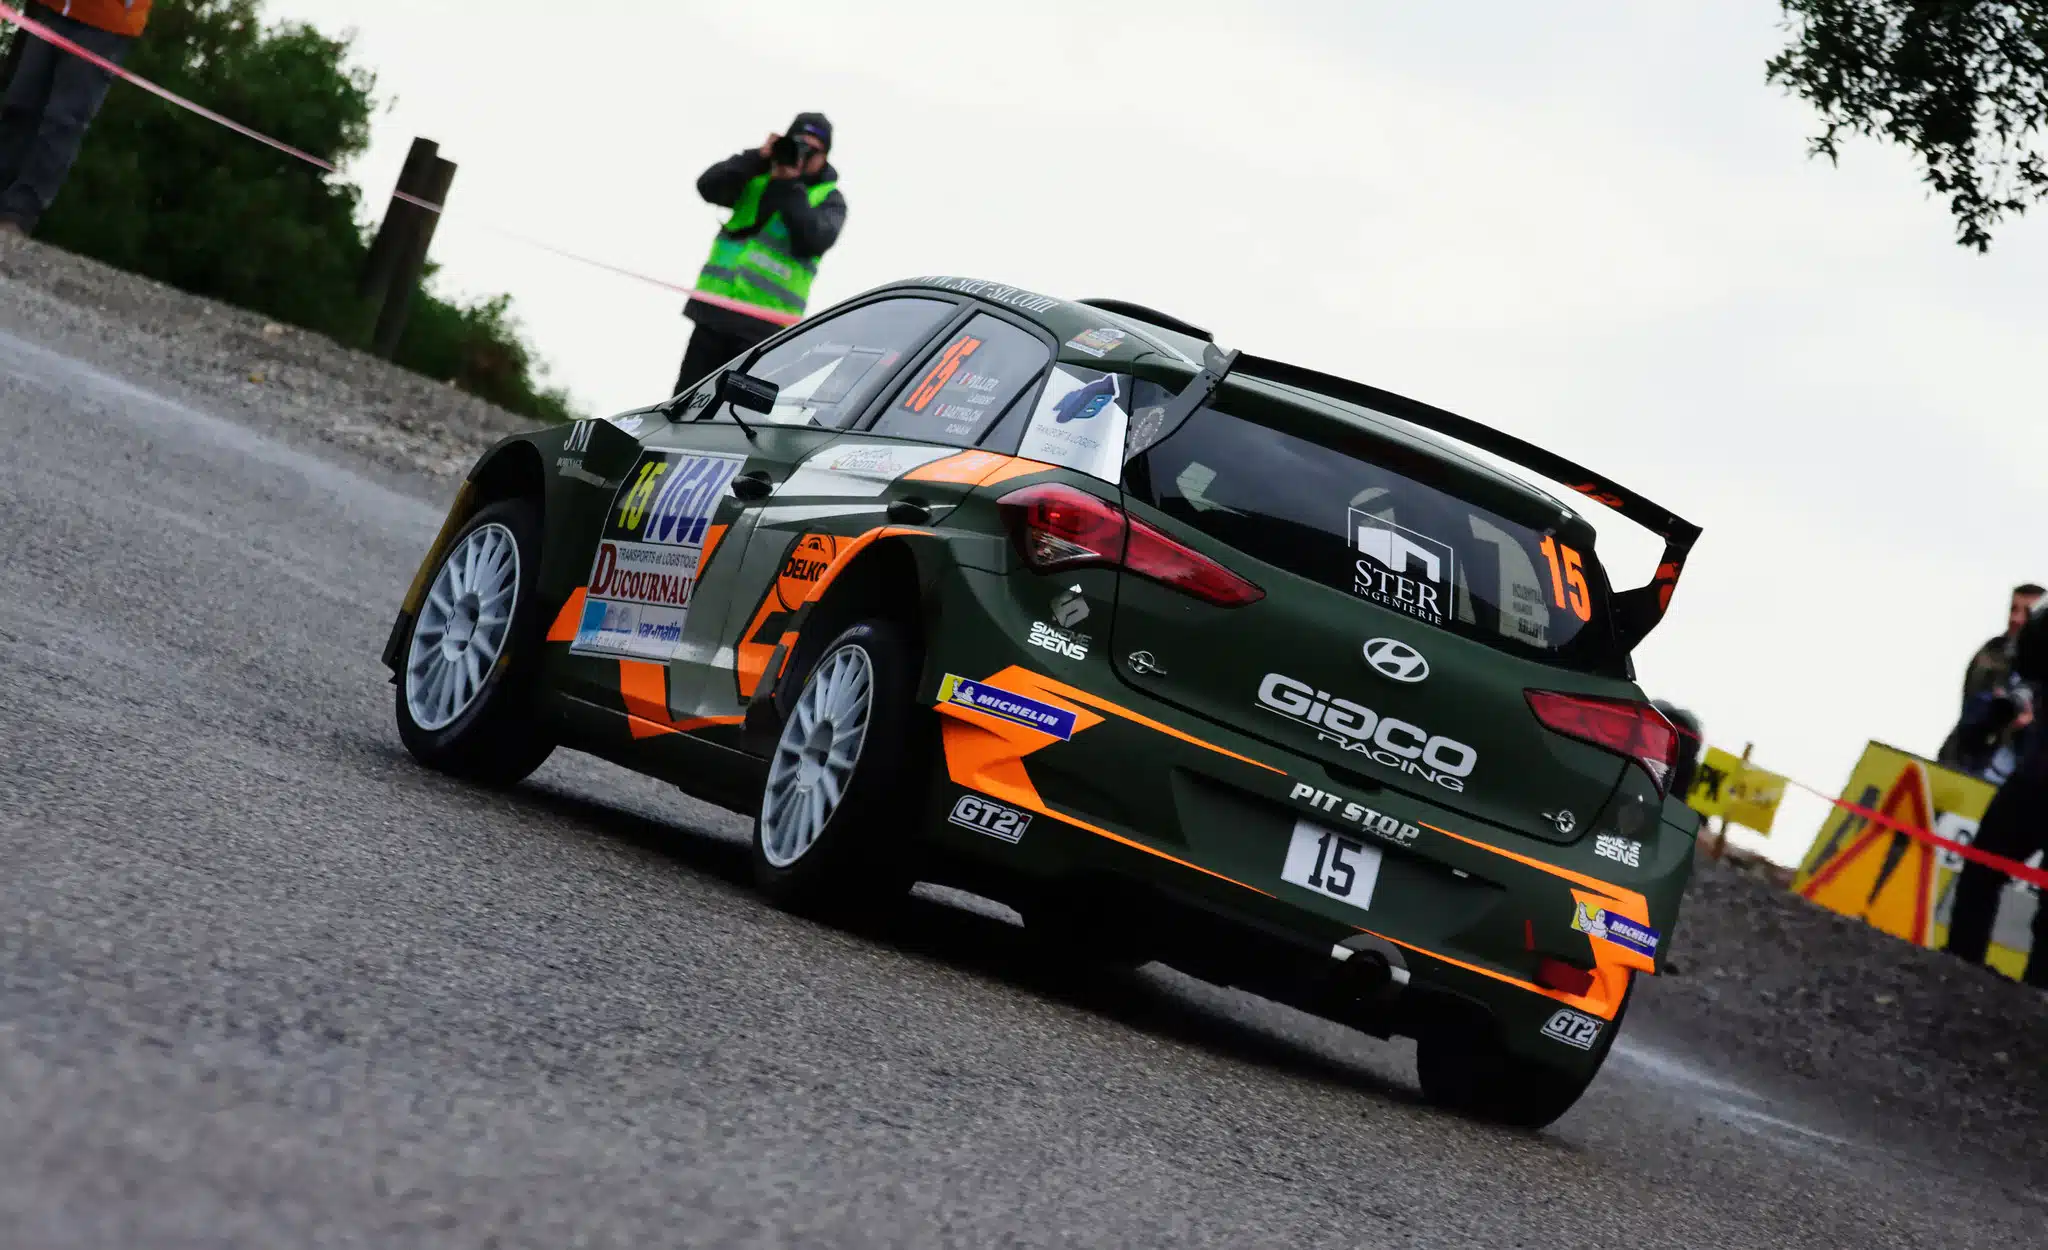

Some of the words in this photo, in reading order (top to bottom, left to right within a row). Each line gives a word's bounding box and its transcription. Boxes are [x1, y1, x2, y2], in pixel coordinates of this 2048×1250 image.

[904, 335, 982, 413] 15
[563, 419, 597, 453] JM
[617, 461, 668, 531] 15
[644, 457, 739, 544] IGOL
[618, 547, 657, 565] TRANSPORTS
[661, 552, 698, 570] LOGISTIQUE
[782, 557, 828, 583] DELKO
[1539, 535, 1592, 623] 15
[1353, 583, 1442, 626] INGENIERIE
[1355, 559, 1442, 616] STER
[638, 620, 681, 642] var-matin
[1027, 631, 1089, 661] SENS
[976, 694, 1060, 727] MICHELIN
[1317, 732, 1465, 793] RACING
[955, 797, 1029, 838] GT2i
[1289, 782, 1343, 812] PIT
[1341, 802, 1420, 840] STOP
[1307, 832, 1362, 898] 15
[1593, 839, 1641, 869] SENS
